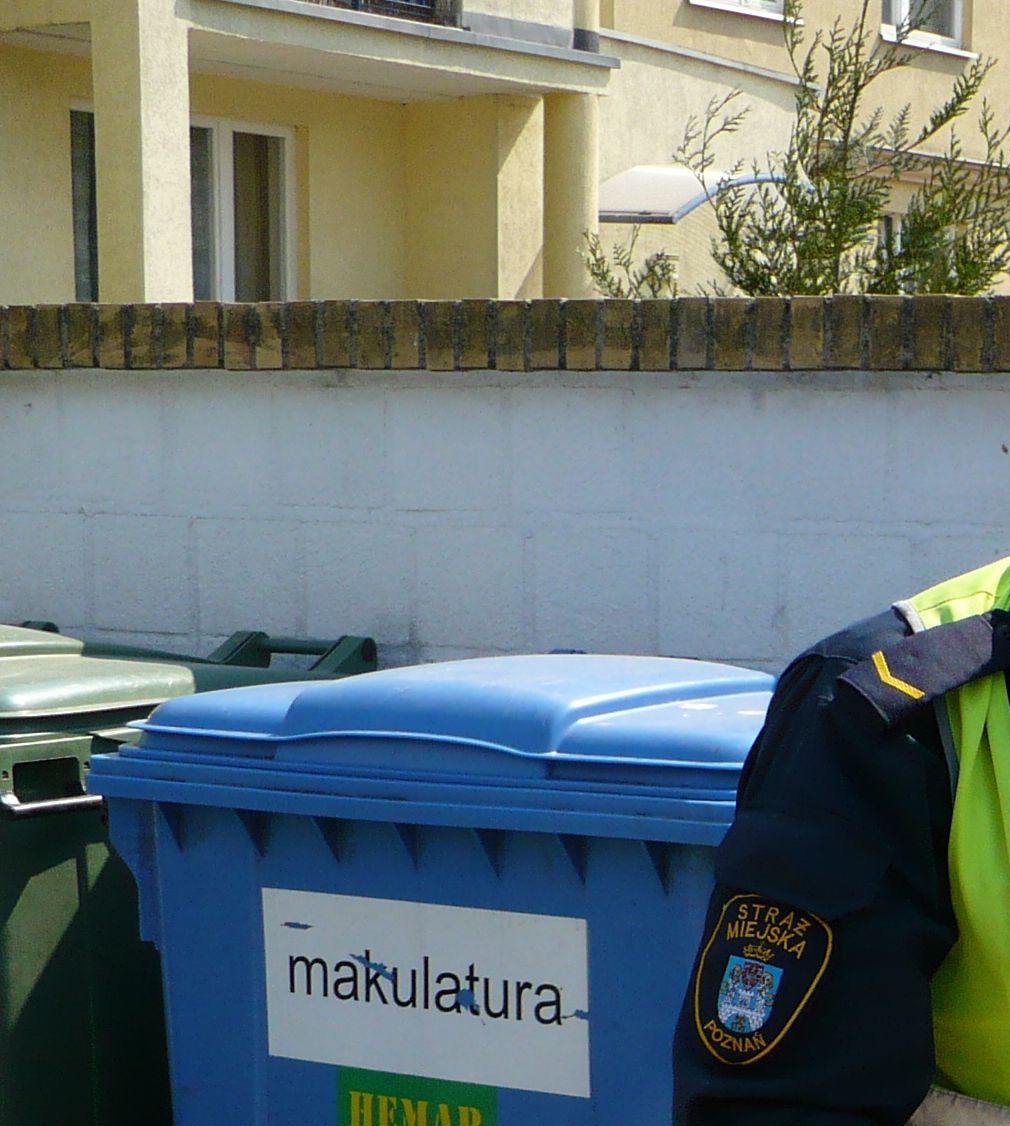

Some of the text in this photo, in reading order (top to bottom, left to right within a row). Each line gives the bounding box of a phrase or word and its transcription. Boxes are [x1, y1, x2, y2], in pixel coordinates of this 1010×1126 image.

[726, 921, 807, 960] MIEJSKA
[289, 949, 563, 1026] makulatura
[703, 1018, 767, 1052] POZNAŃ
